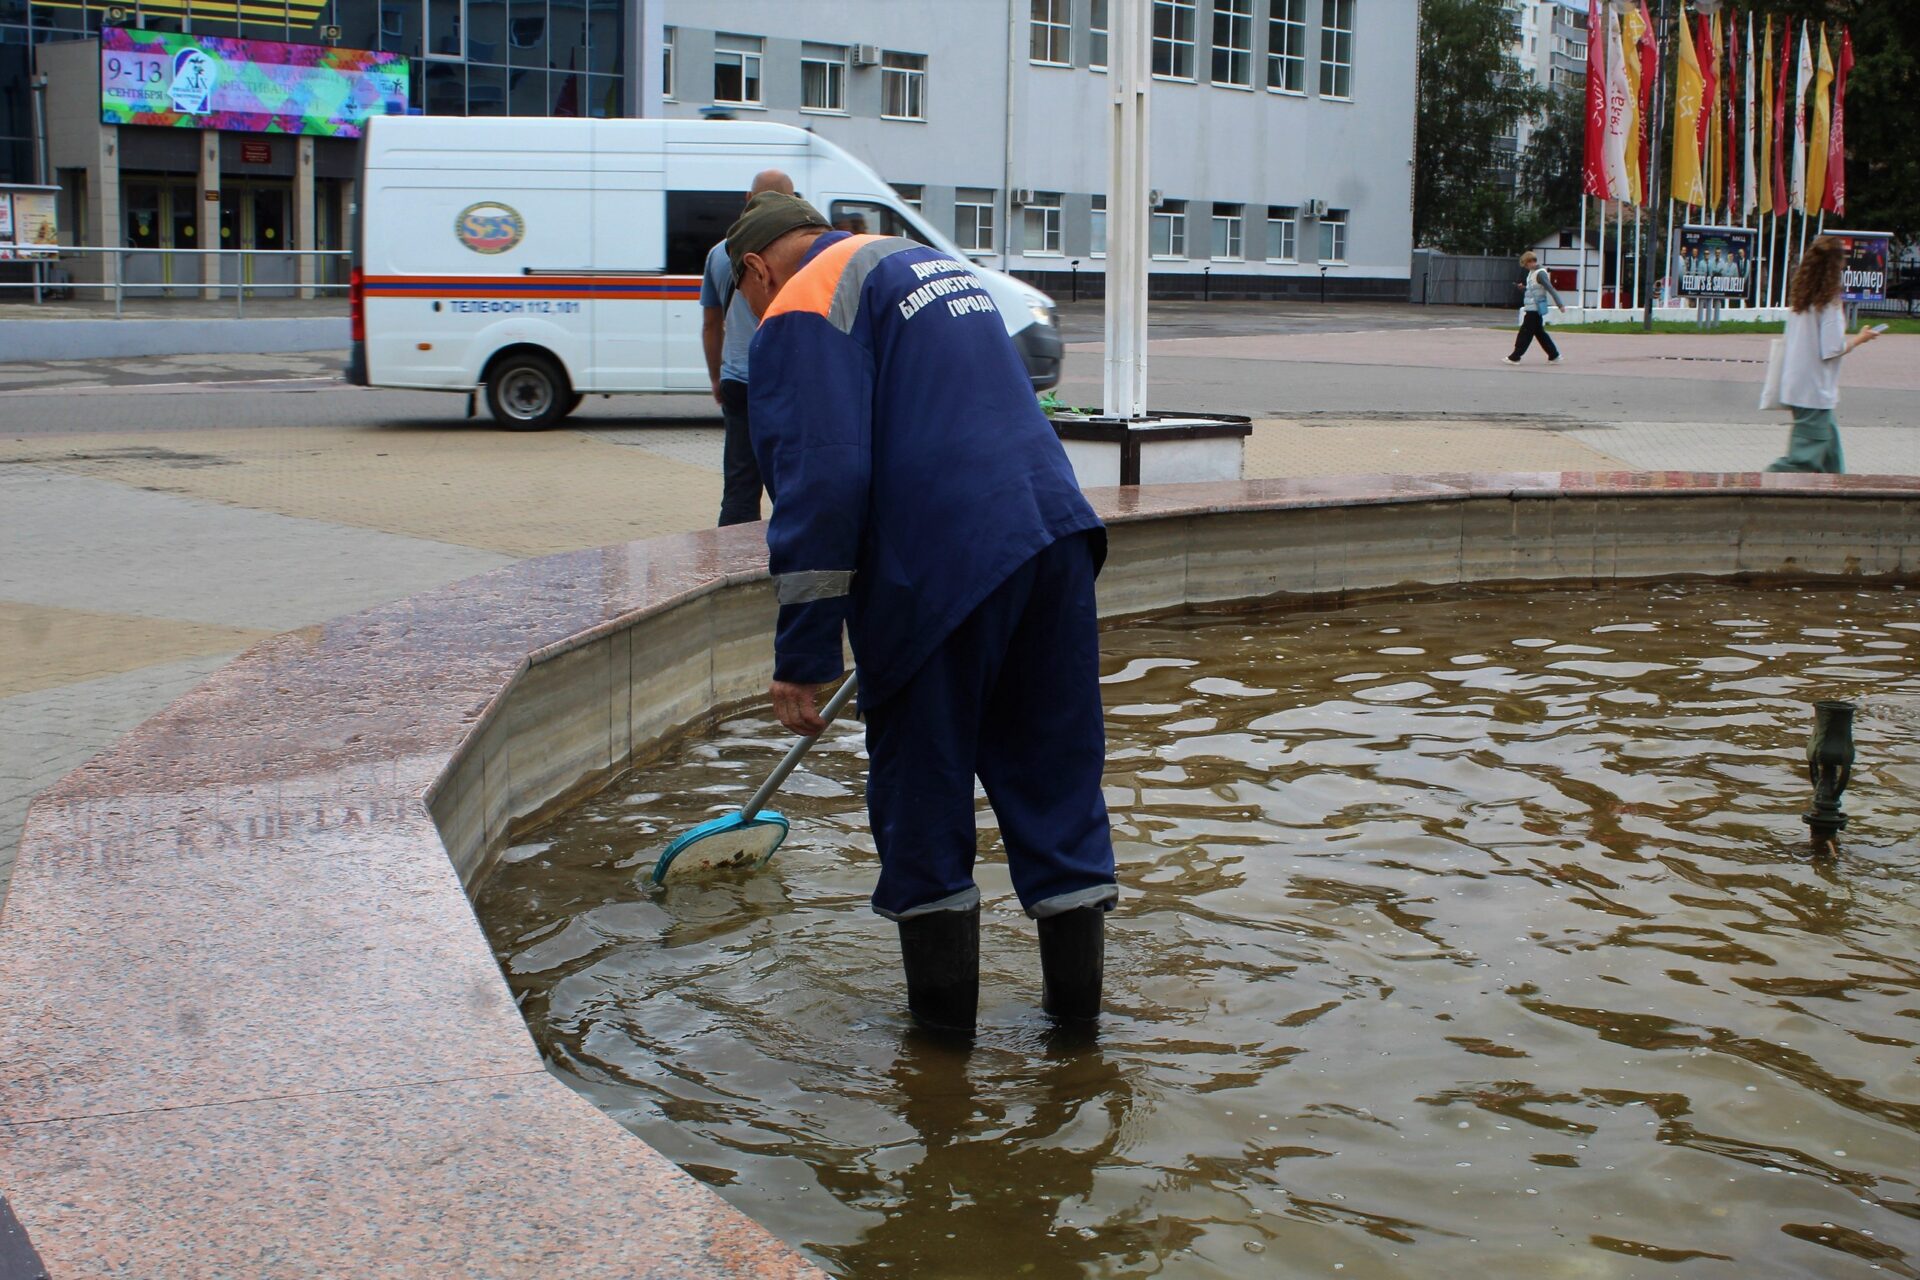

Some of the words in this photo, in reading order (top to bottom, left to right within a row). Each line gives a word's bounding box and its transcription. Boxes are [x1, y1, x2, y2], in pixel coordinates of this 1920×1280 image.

[107, 57, 163, 84] 9-13
[107, 86, 163, 100] СЕНТЯБРЯ
[1840, 265, 1884, 293] фюмер
[450, 300, 524, 313] ТЕЛЕФОН
[946, 294, 997, 318] ГОРОДА
